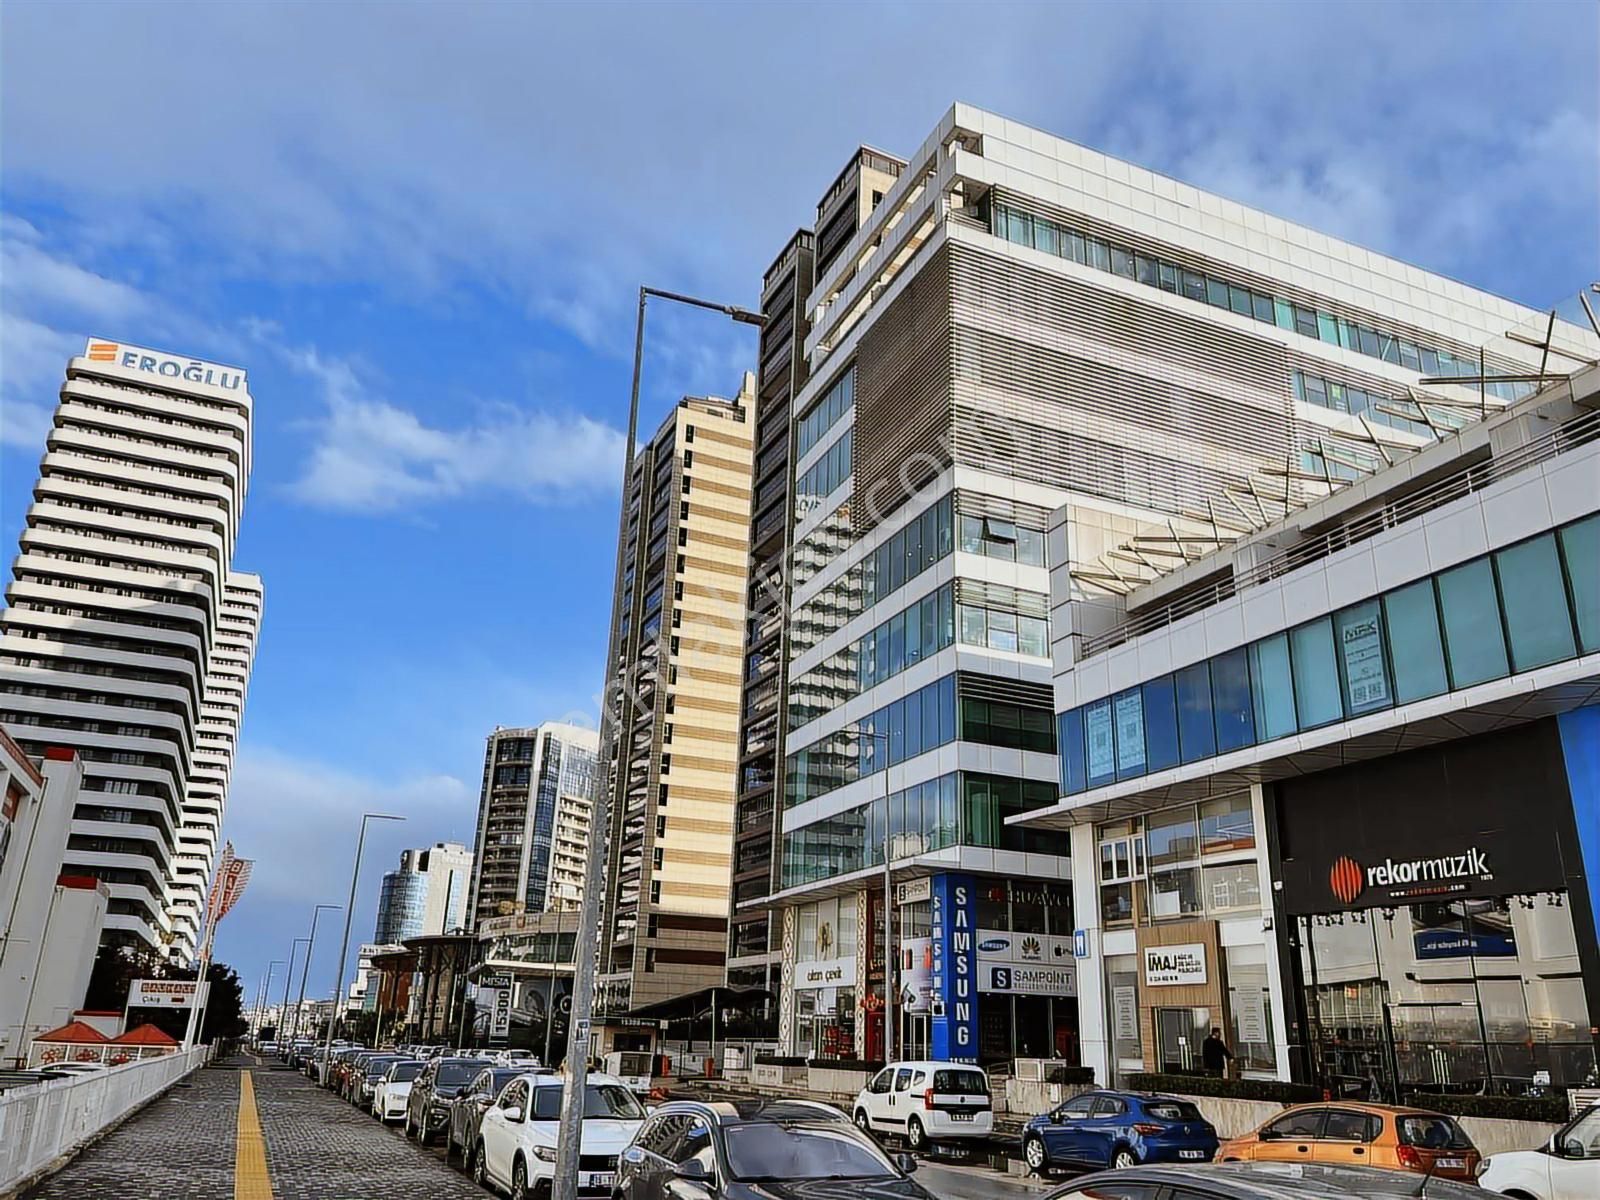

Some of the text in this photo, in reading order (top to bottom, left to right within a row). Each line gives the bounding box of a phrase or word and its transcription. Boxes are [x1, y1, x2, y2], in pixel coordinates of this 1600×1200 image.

[121, 351, 241, 390] EROĞLU
[953, 886, 971, 1046] SAMSUNG
[495, 990, 510, 1033] 15300
